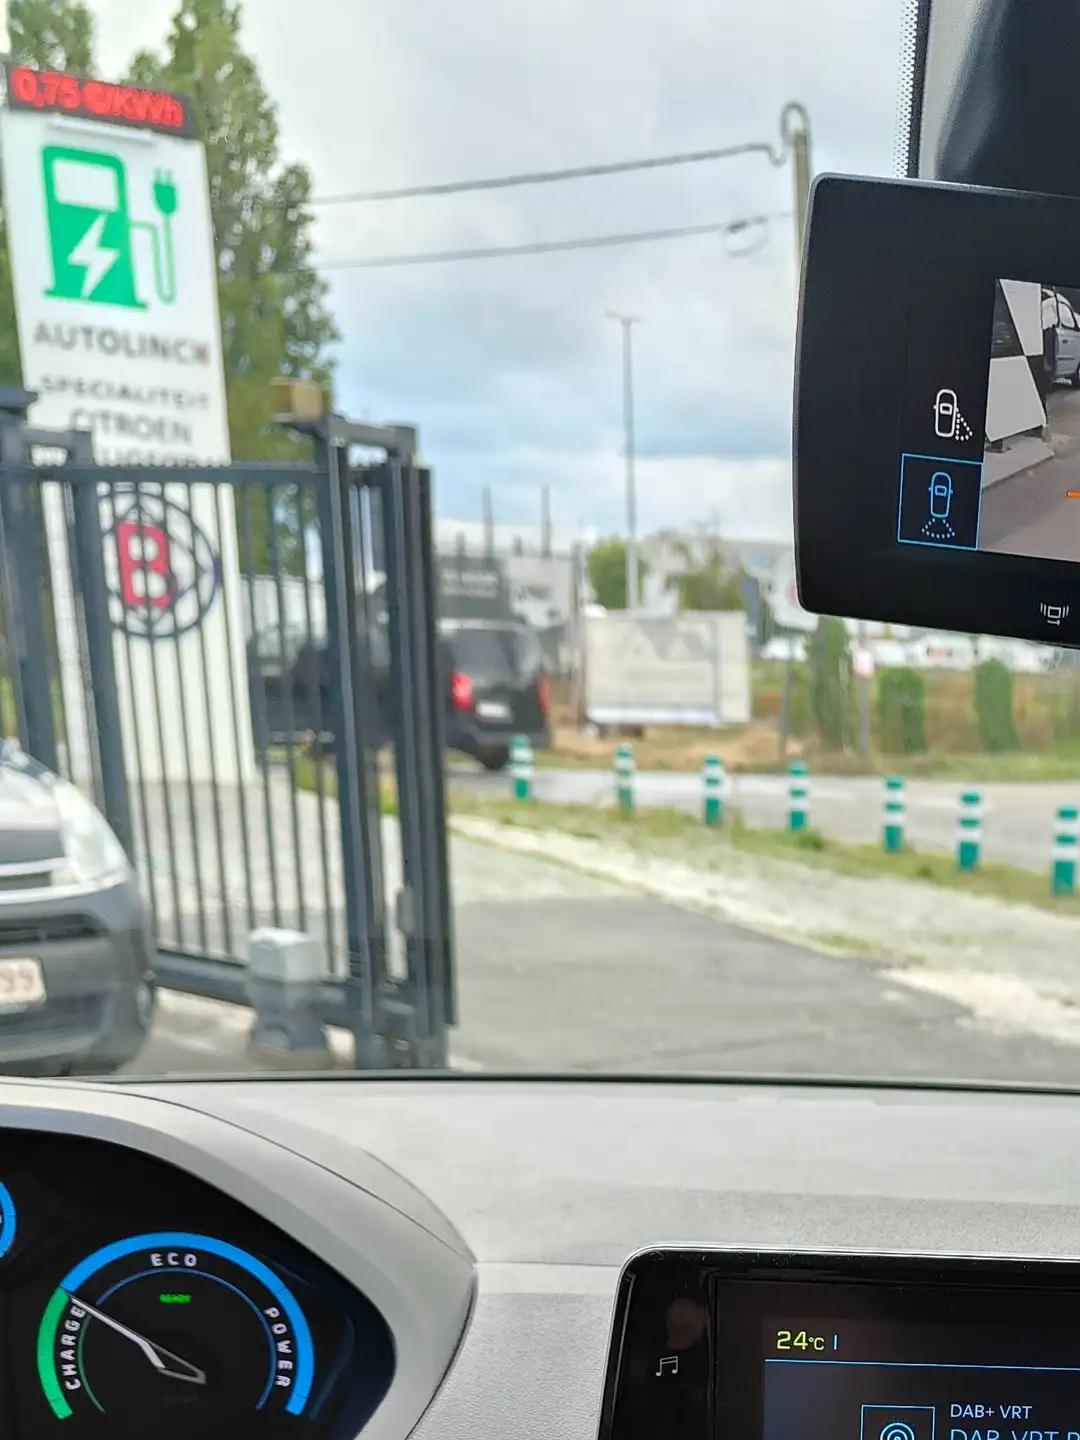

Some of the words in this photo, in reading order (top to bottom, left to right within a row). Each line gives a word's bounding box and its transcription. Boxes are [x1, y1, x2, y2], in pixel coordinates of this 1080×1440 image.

[150, 1252, 198, 1268] ECO
[60, 1303, 87, 1391] CHARGE
[263, 1307, 293, 1388] POWER
[950, 1404, 994, 1418] DAB+
[1000, 1405, 1032, 1419] VRT
